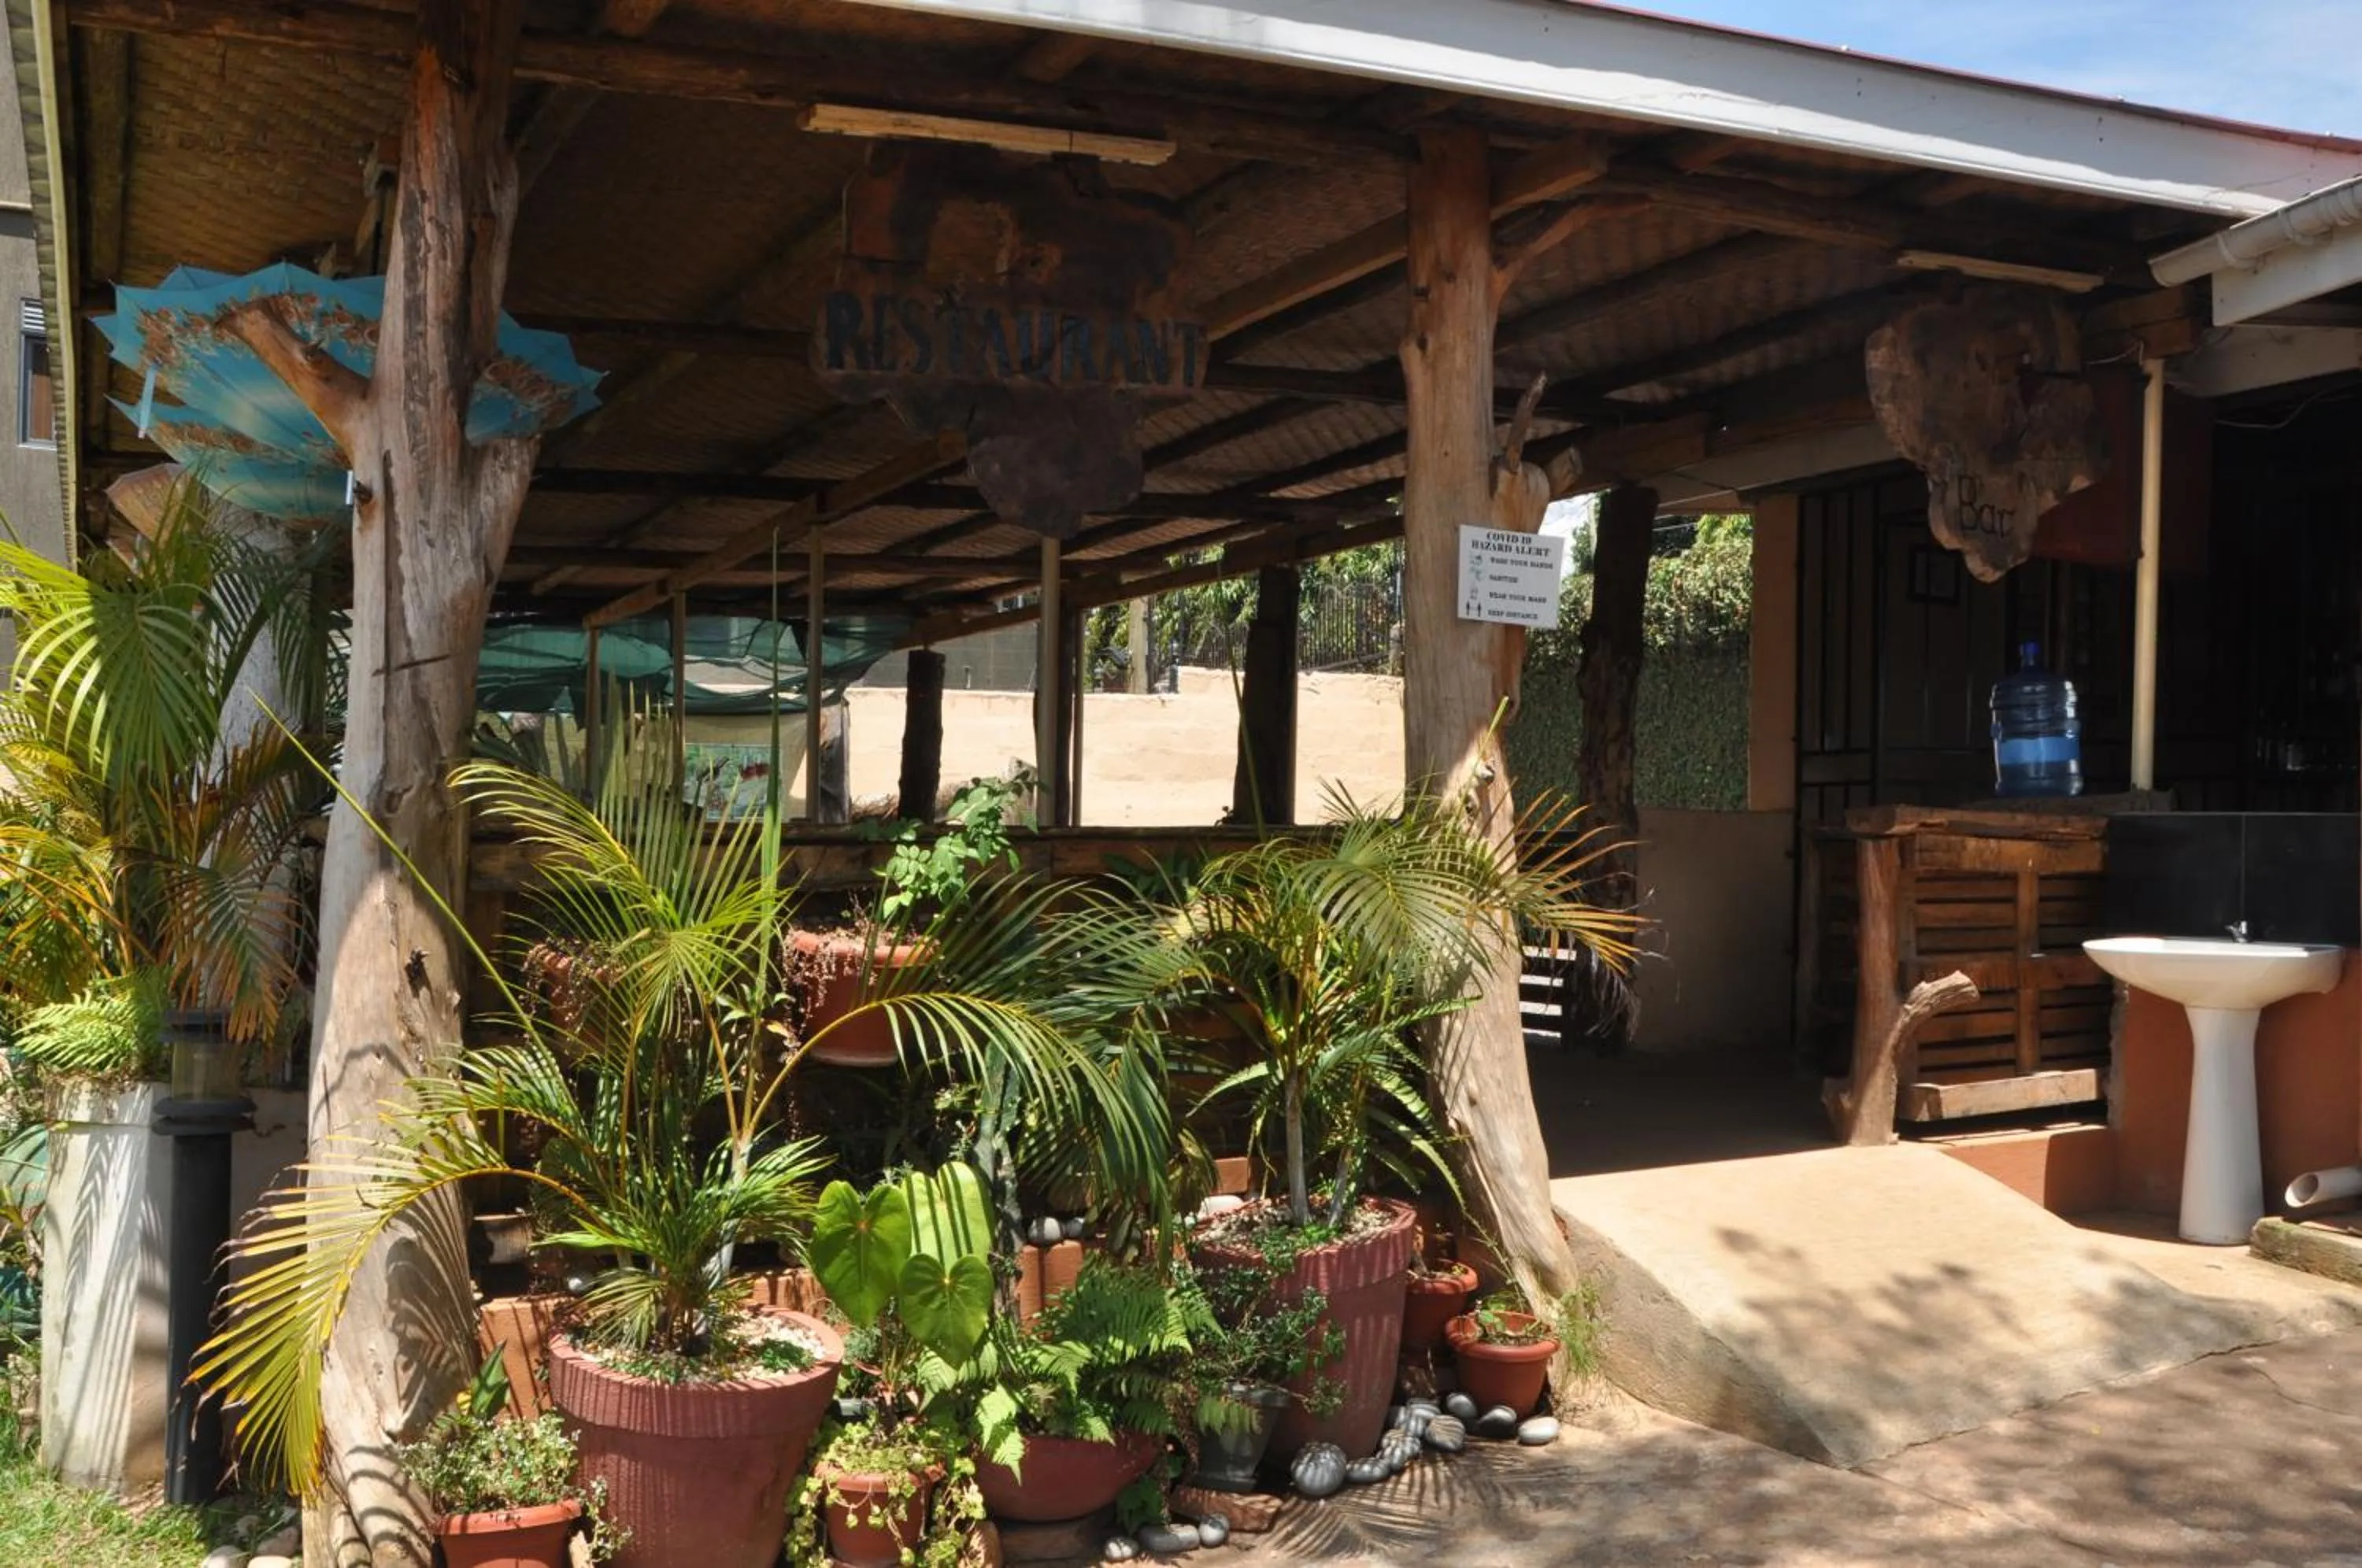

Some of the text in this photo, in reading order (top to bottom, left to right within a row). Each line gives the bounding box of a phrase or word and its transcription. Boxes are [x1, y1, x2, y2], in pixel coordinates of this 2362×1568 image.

[825, 290, 1208, 386] RESTAURANT
[1959, 475, 2016, 539] Bar
[1486, 531, 1531, 545] COVID 19
[1472, 540, 1550, 557] HAZARD ALERT
[1506, 611, 1538, 619] DISTANCE
